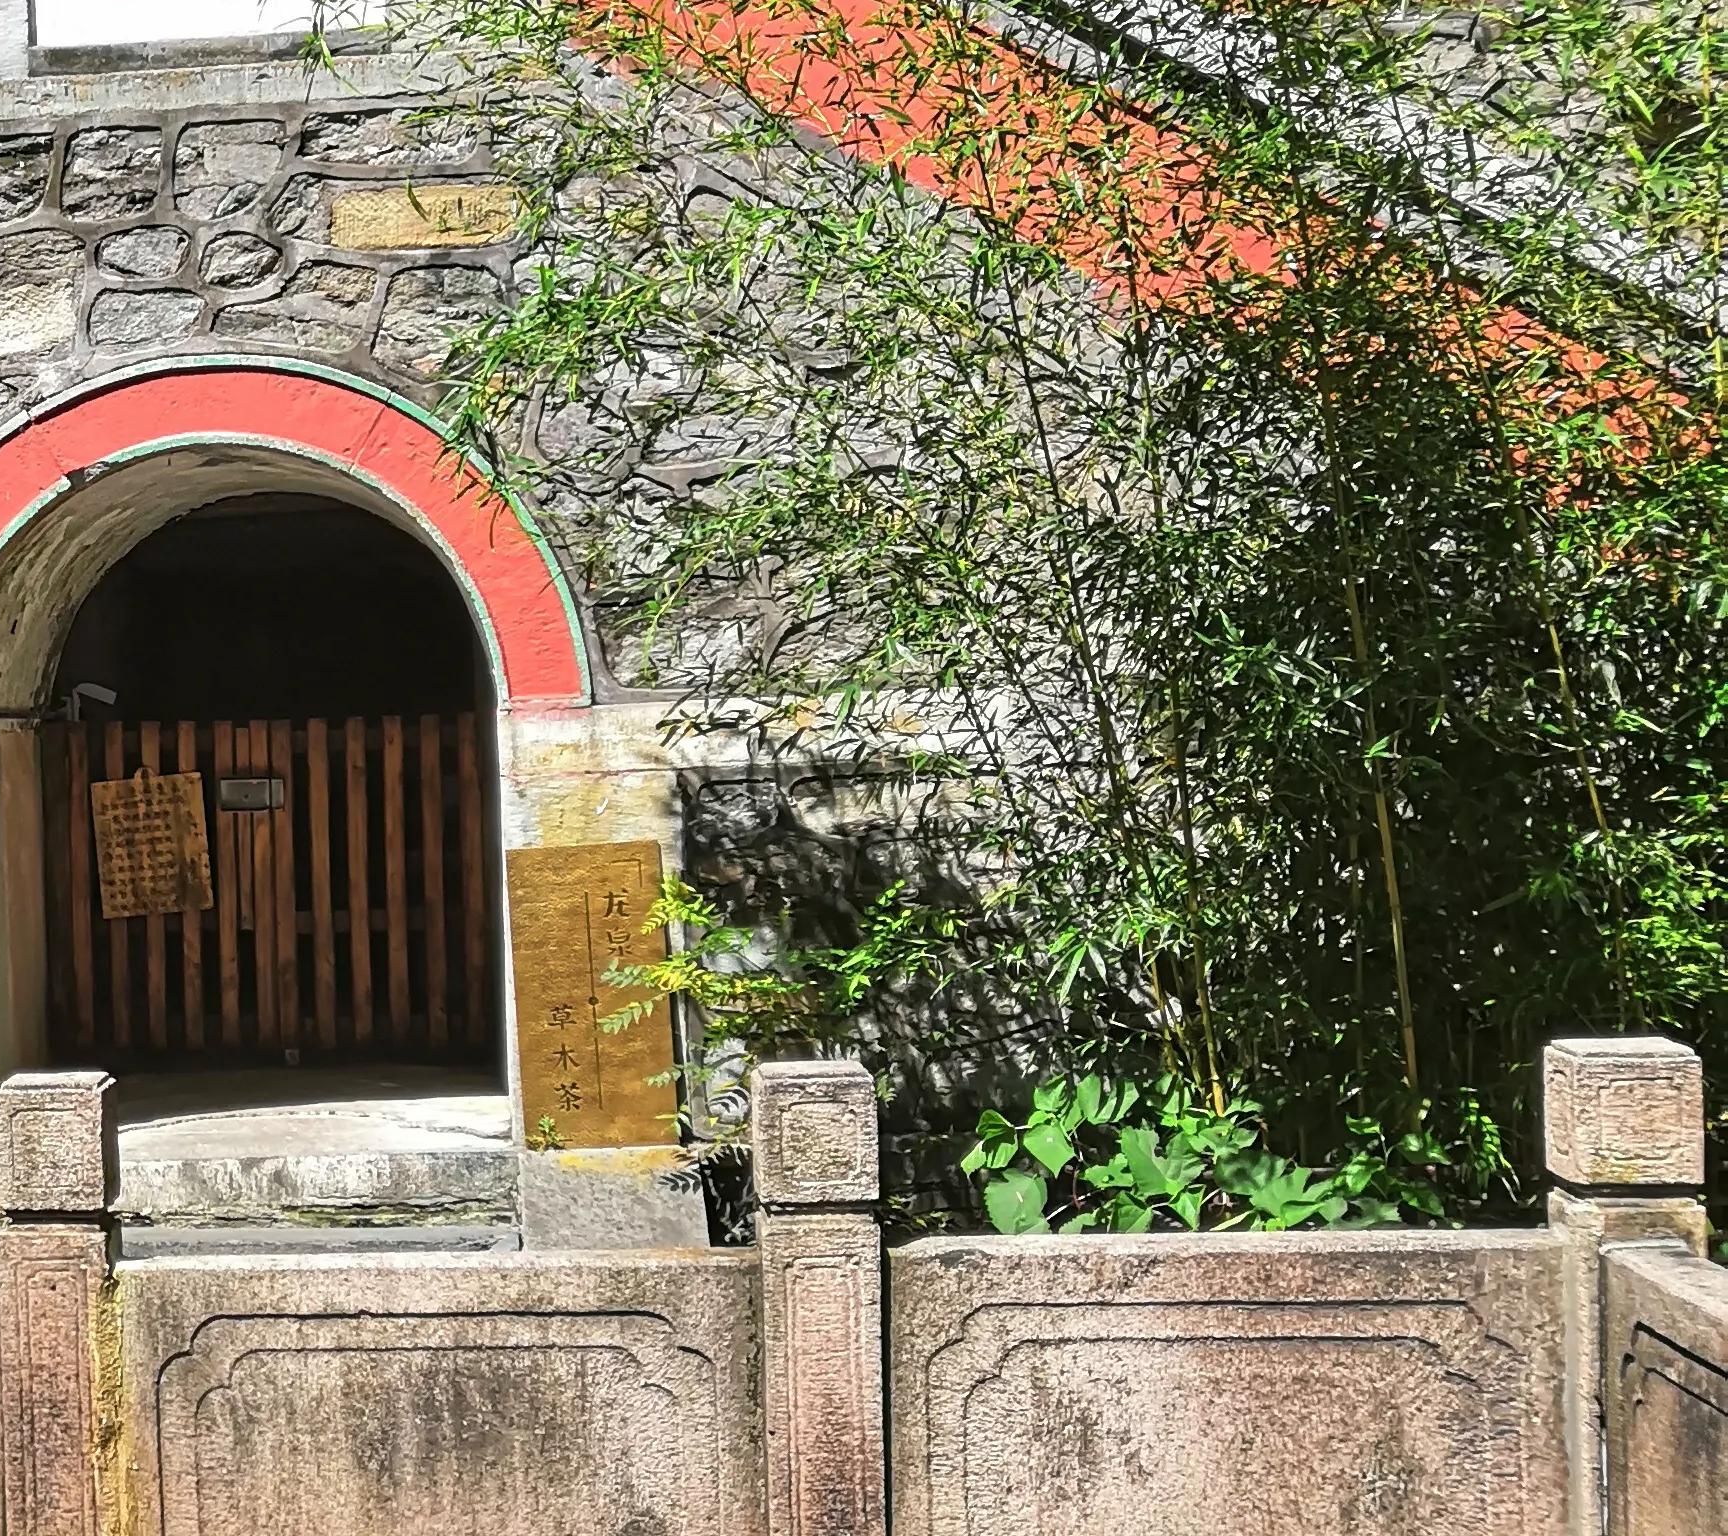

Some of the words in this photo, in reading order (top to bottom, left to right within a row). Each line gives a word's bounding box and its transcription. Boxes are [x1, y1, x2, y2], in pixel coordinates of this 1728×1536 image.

[601, 888, 633, 957] 龙泉
[547, 1003, 583, 1113] 草木茶
